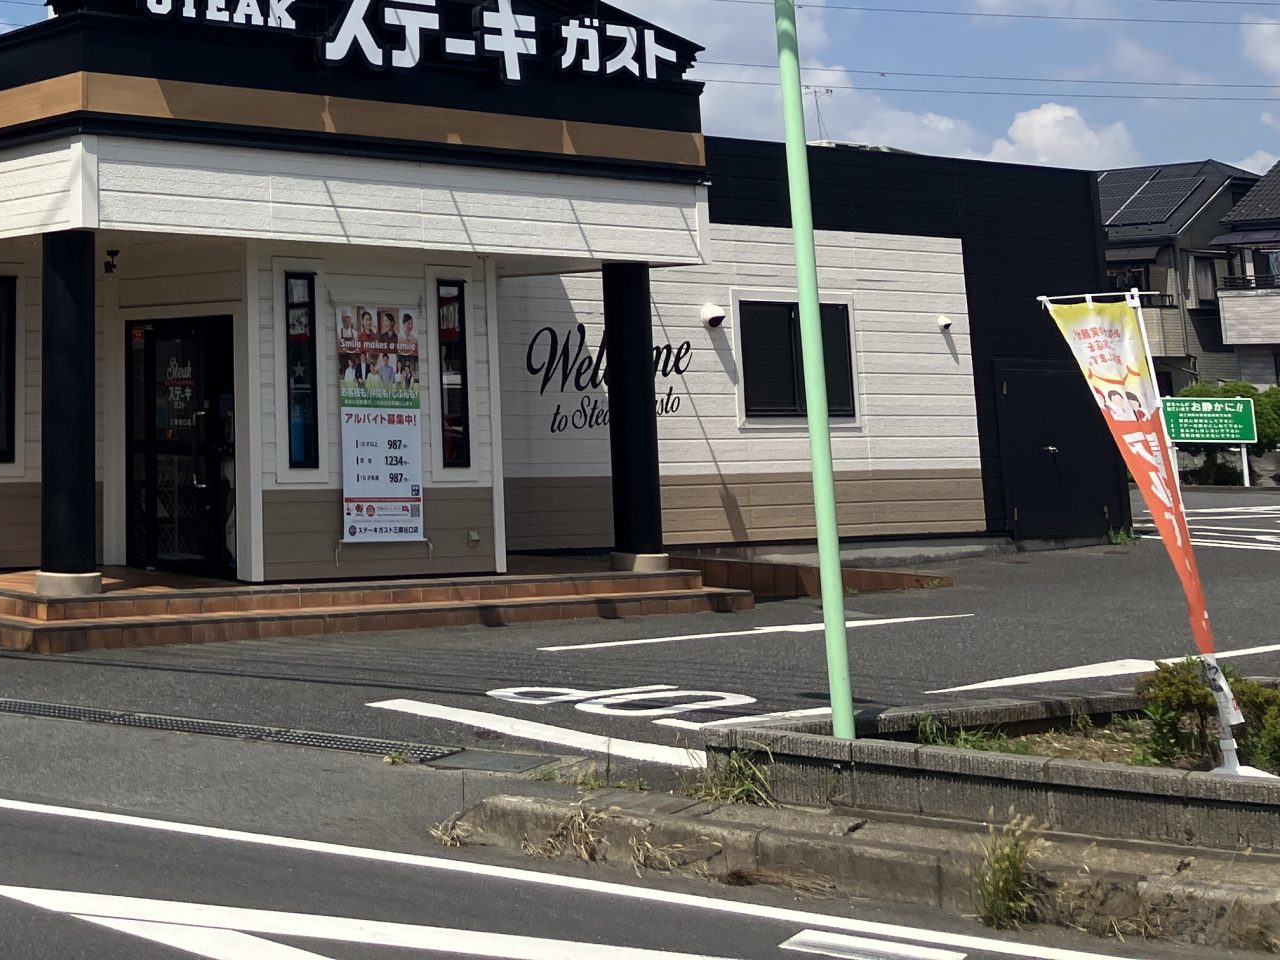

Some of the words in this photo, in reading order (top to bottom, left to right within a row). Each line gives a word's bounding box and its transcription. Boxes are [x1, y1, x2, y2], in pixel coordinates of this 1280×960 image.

[560, 17, 677, 80] ガスト
[340, 339, 361, 349] Smile
[363, 340, 388, 349] makes
[396, 341, 416, 351] smile
[166, 356, 192, 380] Steak
[526, 323, 693, 396] Welme
[168, 386, 192, 401] ステーキ
[550, 404, 568, 434] to
[384, 455, 403, 466] 1234
